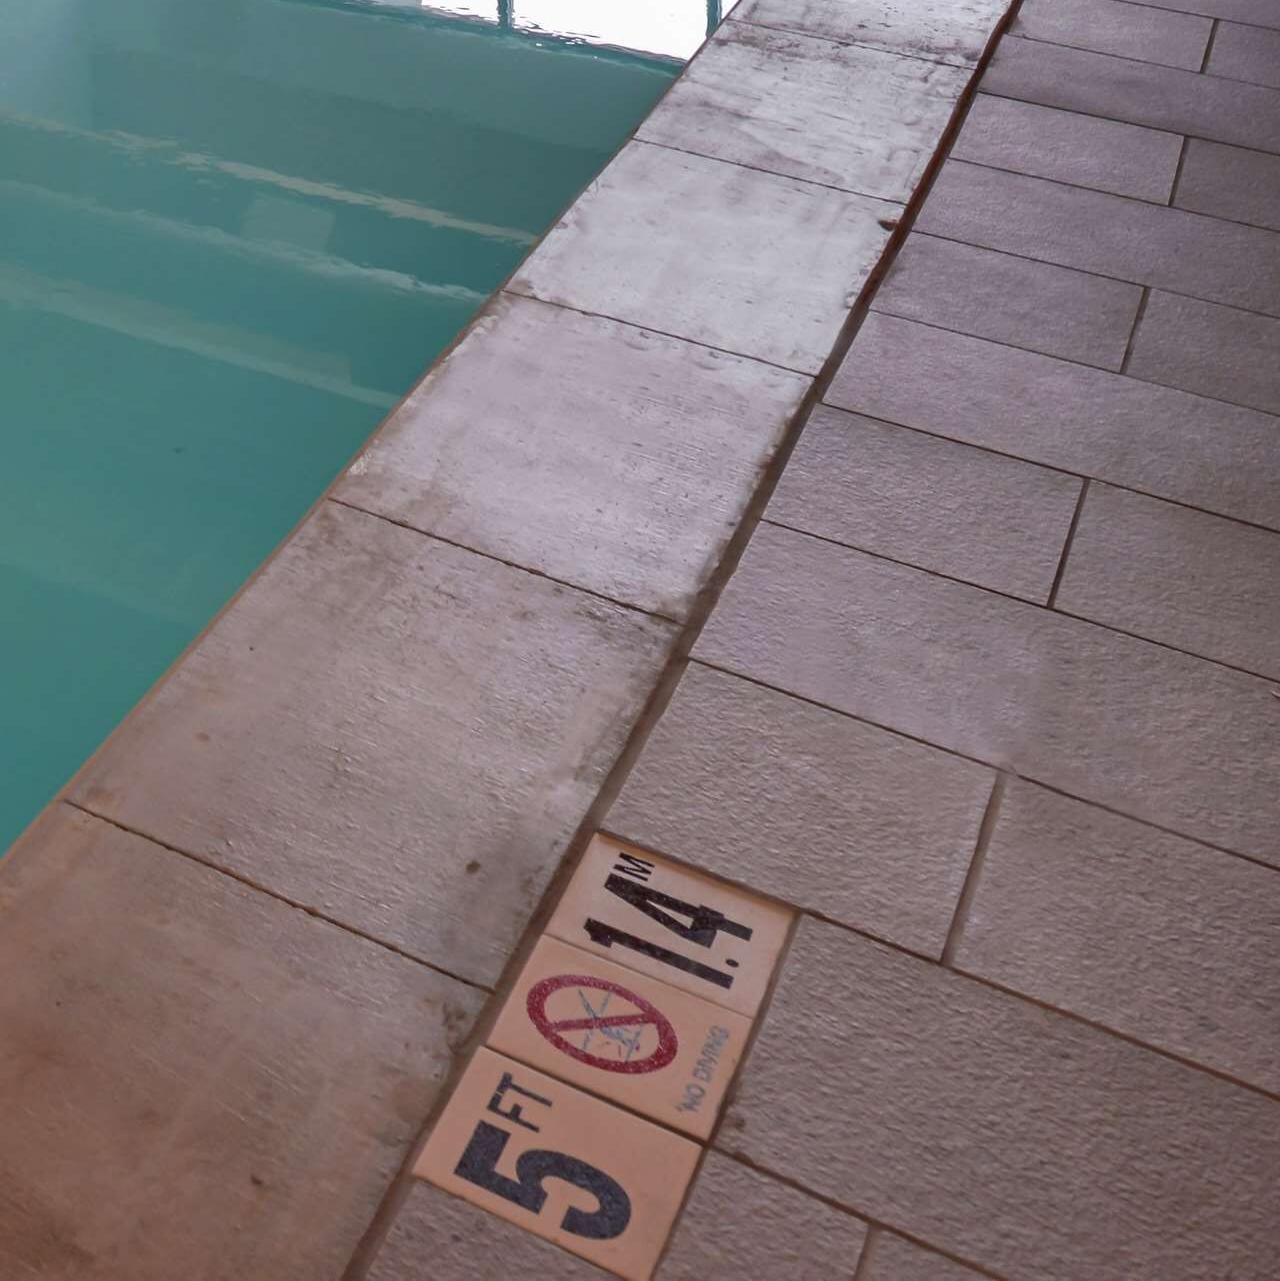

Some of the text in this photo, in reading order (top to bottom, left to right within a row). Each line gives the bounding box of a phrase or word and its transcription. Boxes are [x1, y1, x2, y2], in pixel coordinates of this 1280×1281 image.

[613, 851, 656, 881] M
[486, 1071, 553, 1133] FT
[682, 1024, 730, 1112] NO DIVING
[453, 1119, 632, 1240] 5
